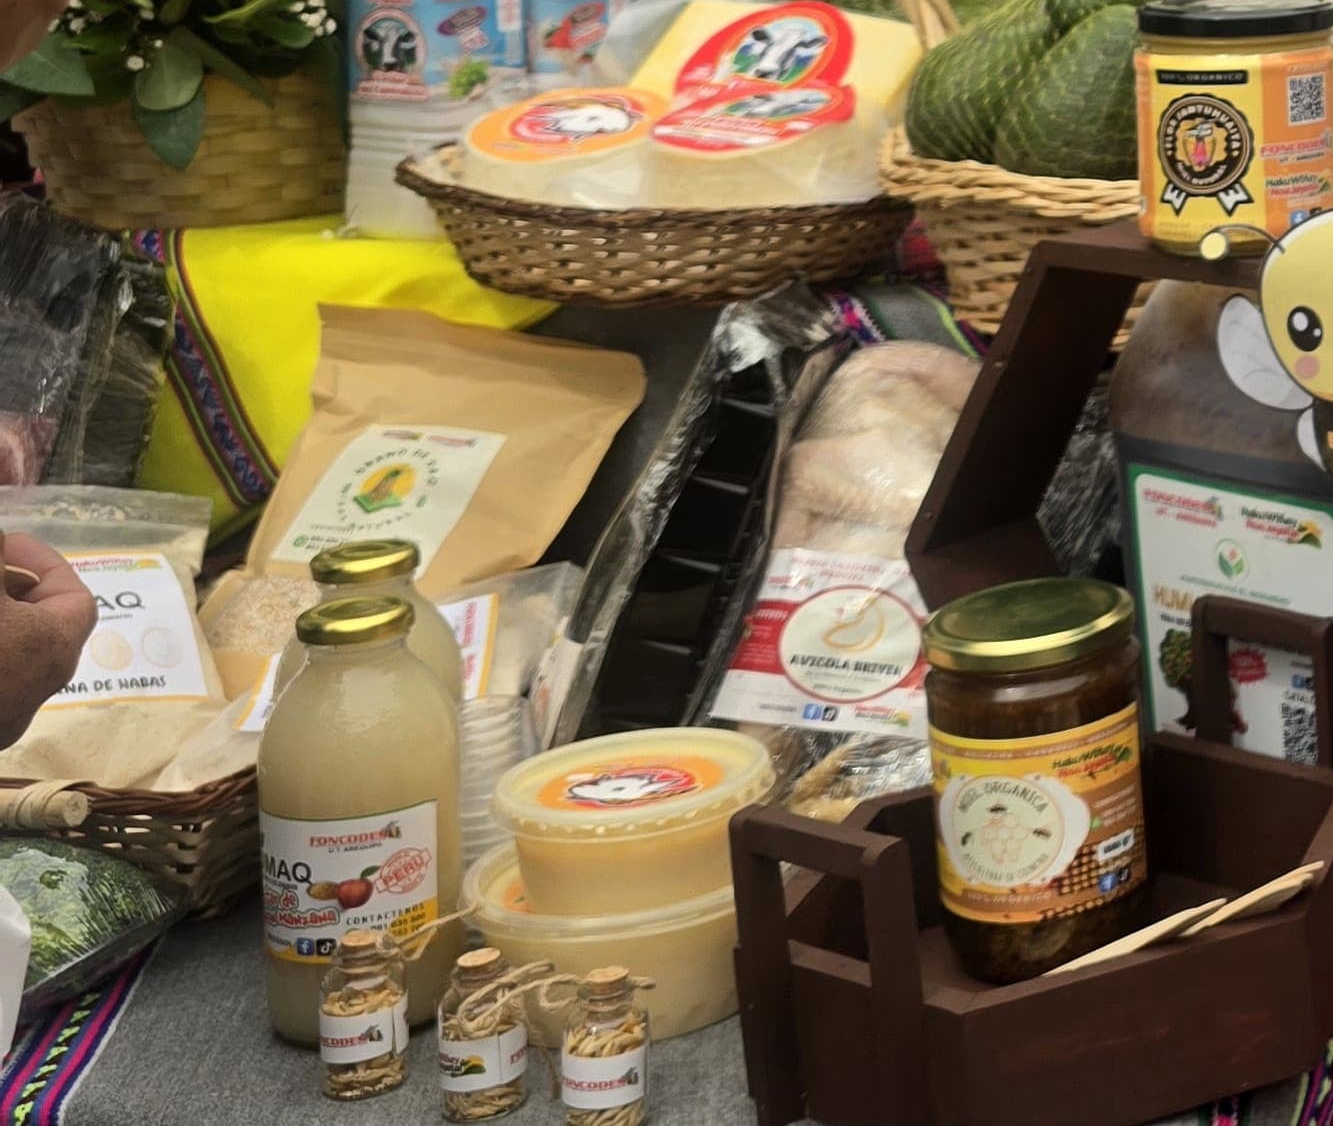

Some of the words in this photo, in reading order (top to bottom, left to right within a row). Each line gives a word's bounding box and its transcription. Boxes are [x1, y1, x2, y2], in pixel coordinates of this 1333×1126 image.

[57, 681, 88, 695] NA
[93, 677, 114, 692] DE
[118, 675, 166, 691] HABAS
[309, 829, 389, 847] FONCODES
